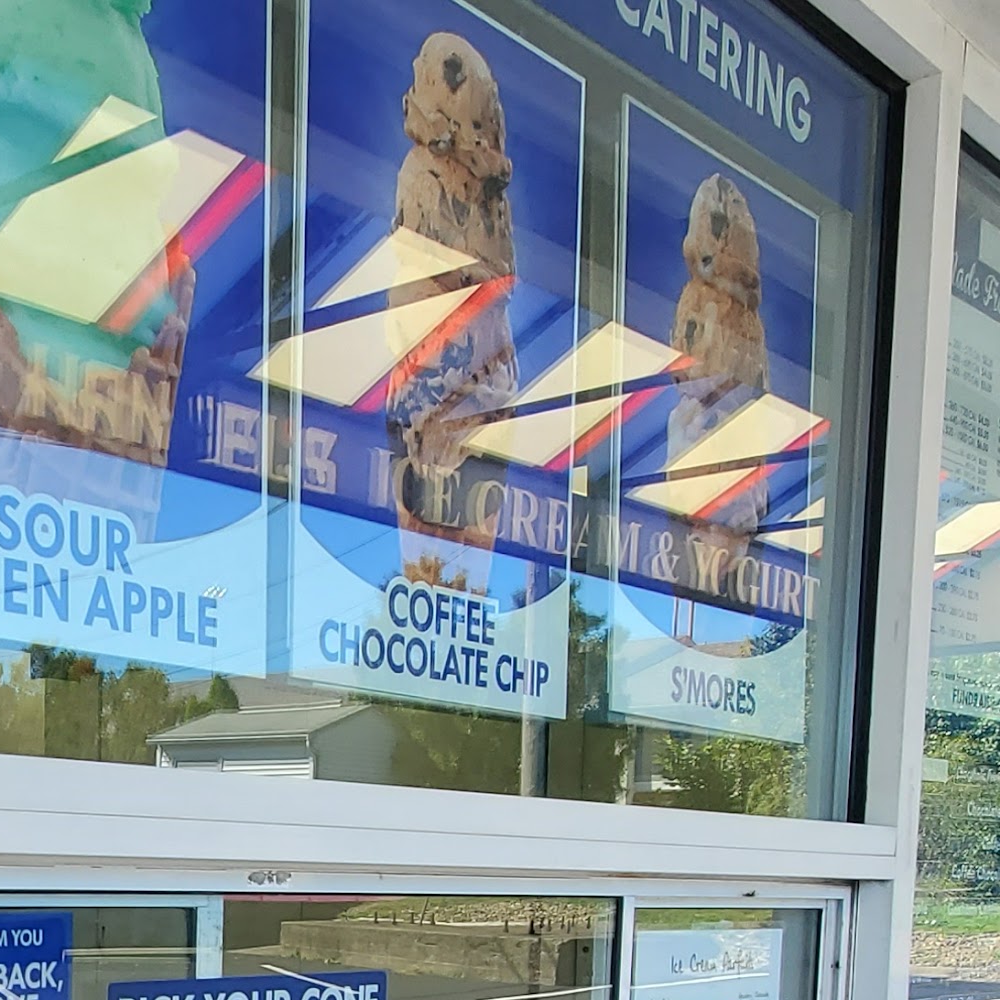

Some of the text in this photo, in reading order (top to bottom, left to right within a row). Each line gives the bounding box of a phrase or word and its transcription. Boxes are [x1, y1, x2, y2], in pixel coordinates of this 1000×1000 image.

[616, 0, 811, 143] CATERING
[85, 575, 218, 647] APPLE
[388, 582, 495, 646] COFFEE
[318, 617, 549, 698] CHOCOLATE CHIP
[670, 663, 756, 716] S'MORES
[11, 929, 43, 947] YOU
